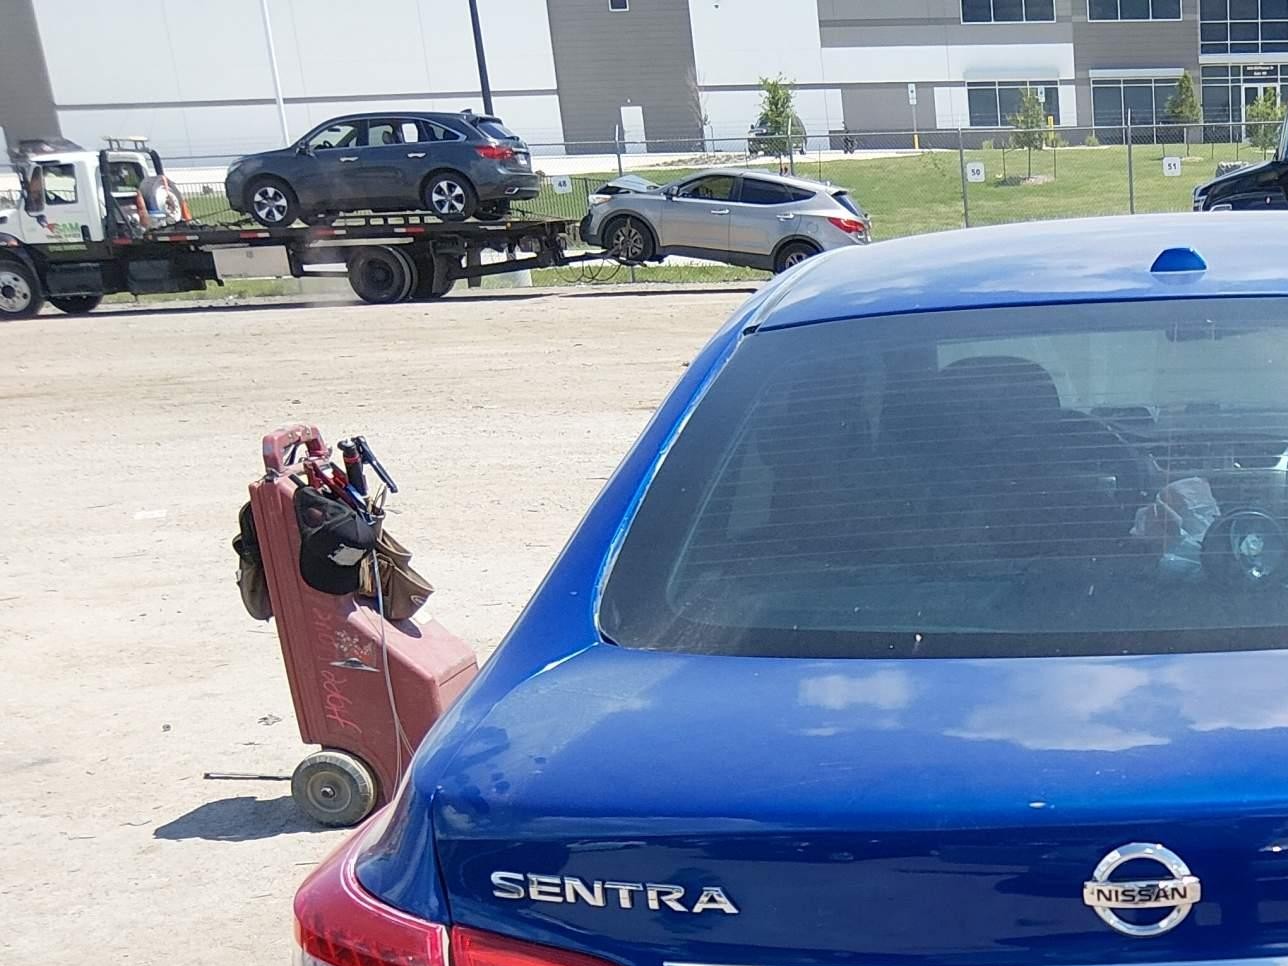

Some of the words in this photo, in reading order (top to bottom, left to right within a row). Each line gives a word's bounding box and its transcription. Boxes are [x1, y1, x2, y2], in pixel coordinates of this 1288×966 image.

[971, 168, 981, 176] 50
[490, 871, 740, 914] SENTRA
[1096, 886, 1188, 903] NISSAN
